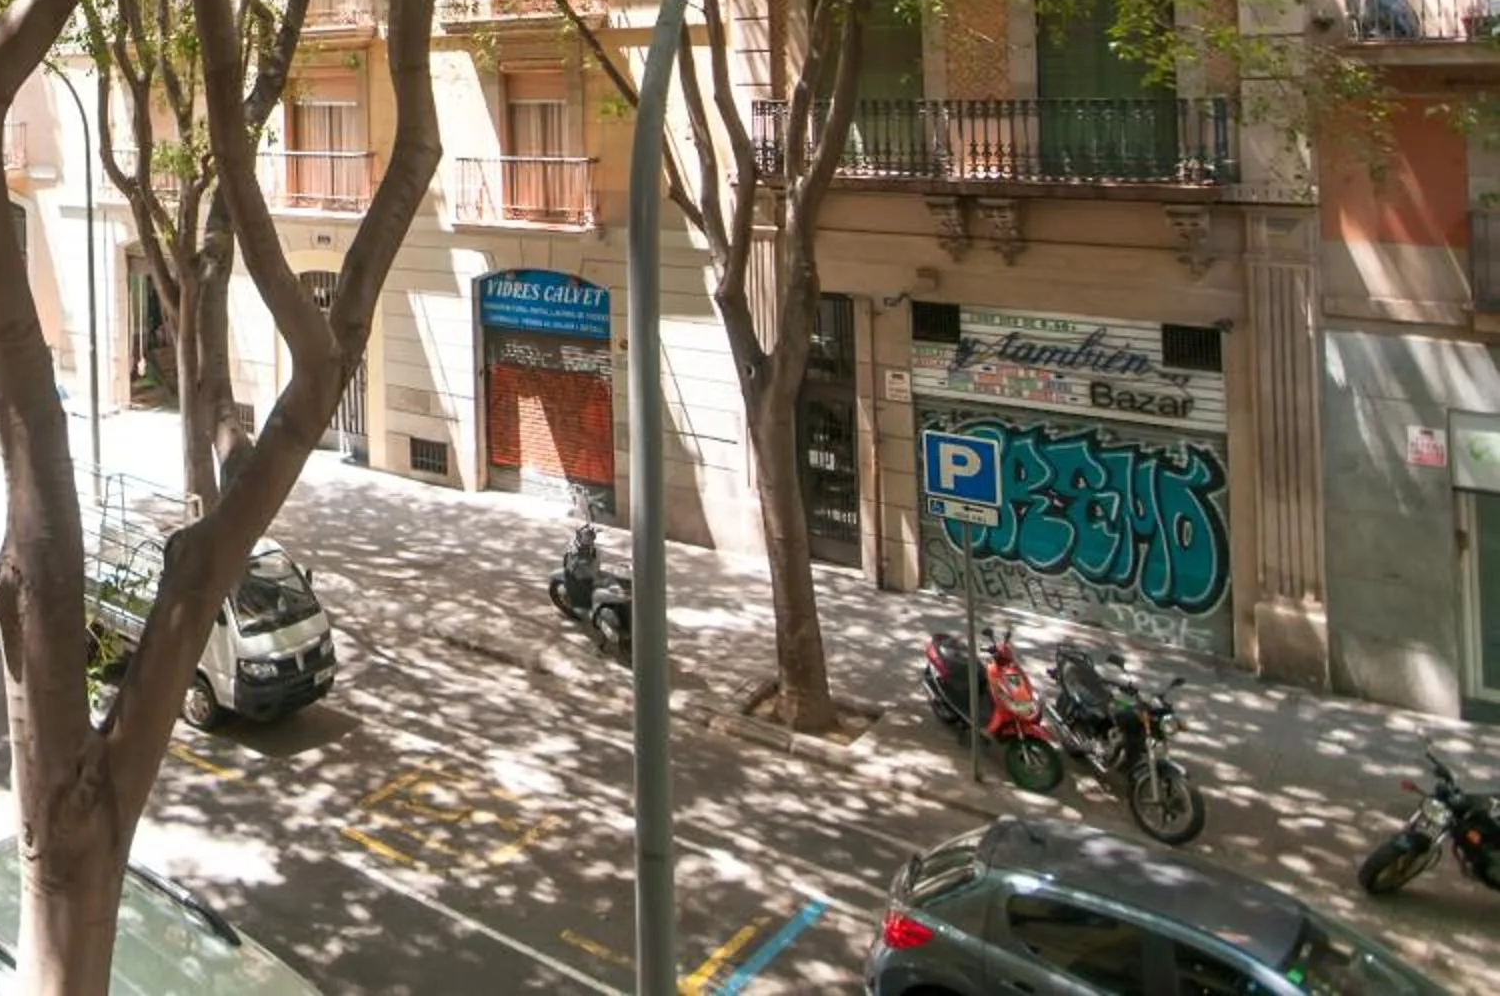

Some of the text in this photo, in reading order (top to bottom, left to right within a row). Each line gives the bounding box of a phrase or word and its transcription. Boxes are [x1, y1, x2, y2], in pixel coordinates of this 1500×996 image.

[485, 279, 602, 307] VIDRES CALVET
[1089, 381, 1194, 419] Bazar
[938, 442, 982, 491] P
